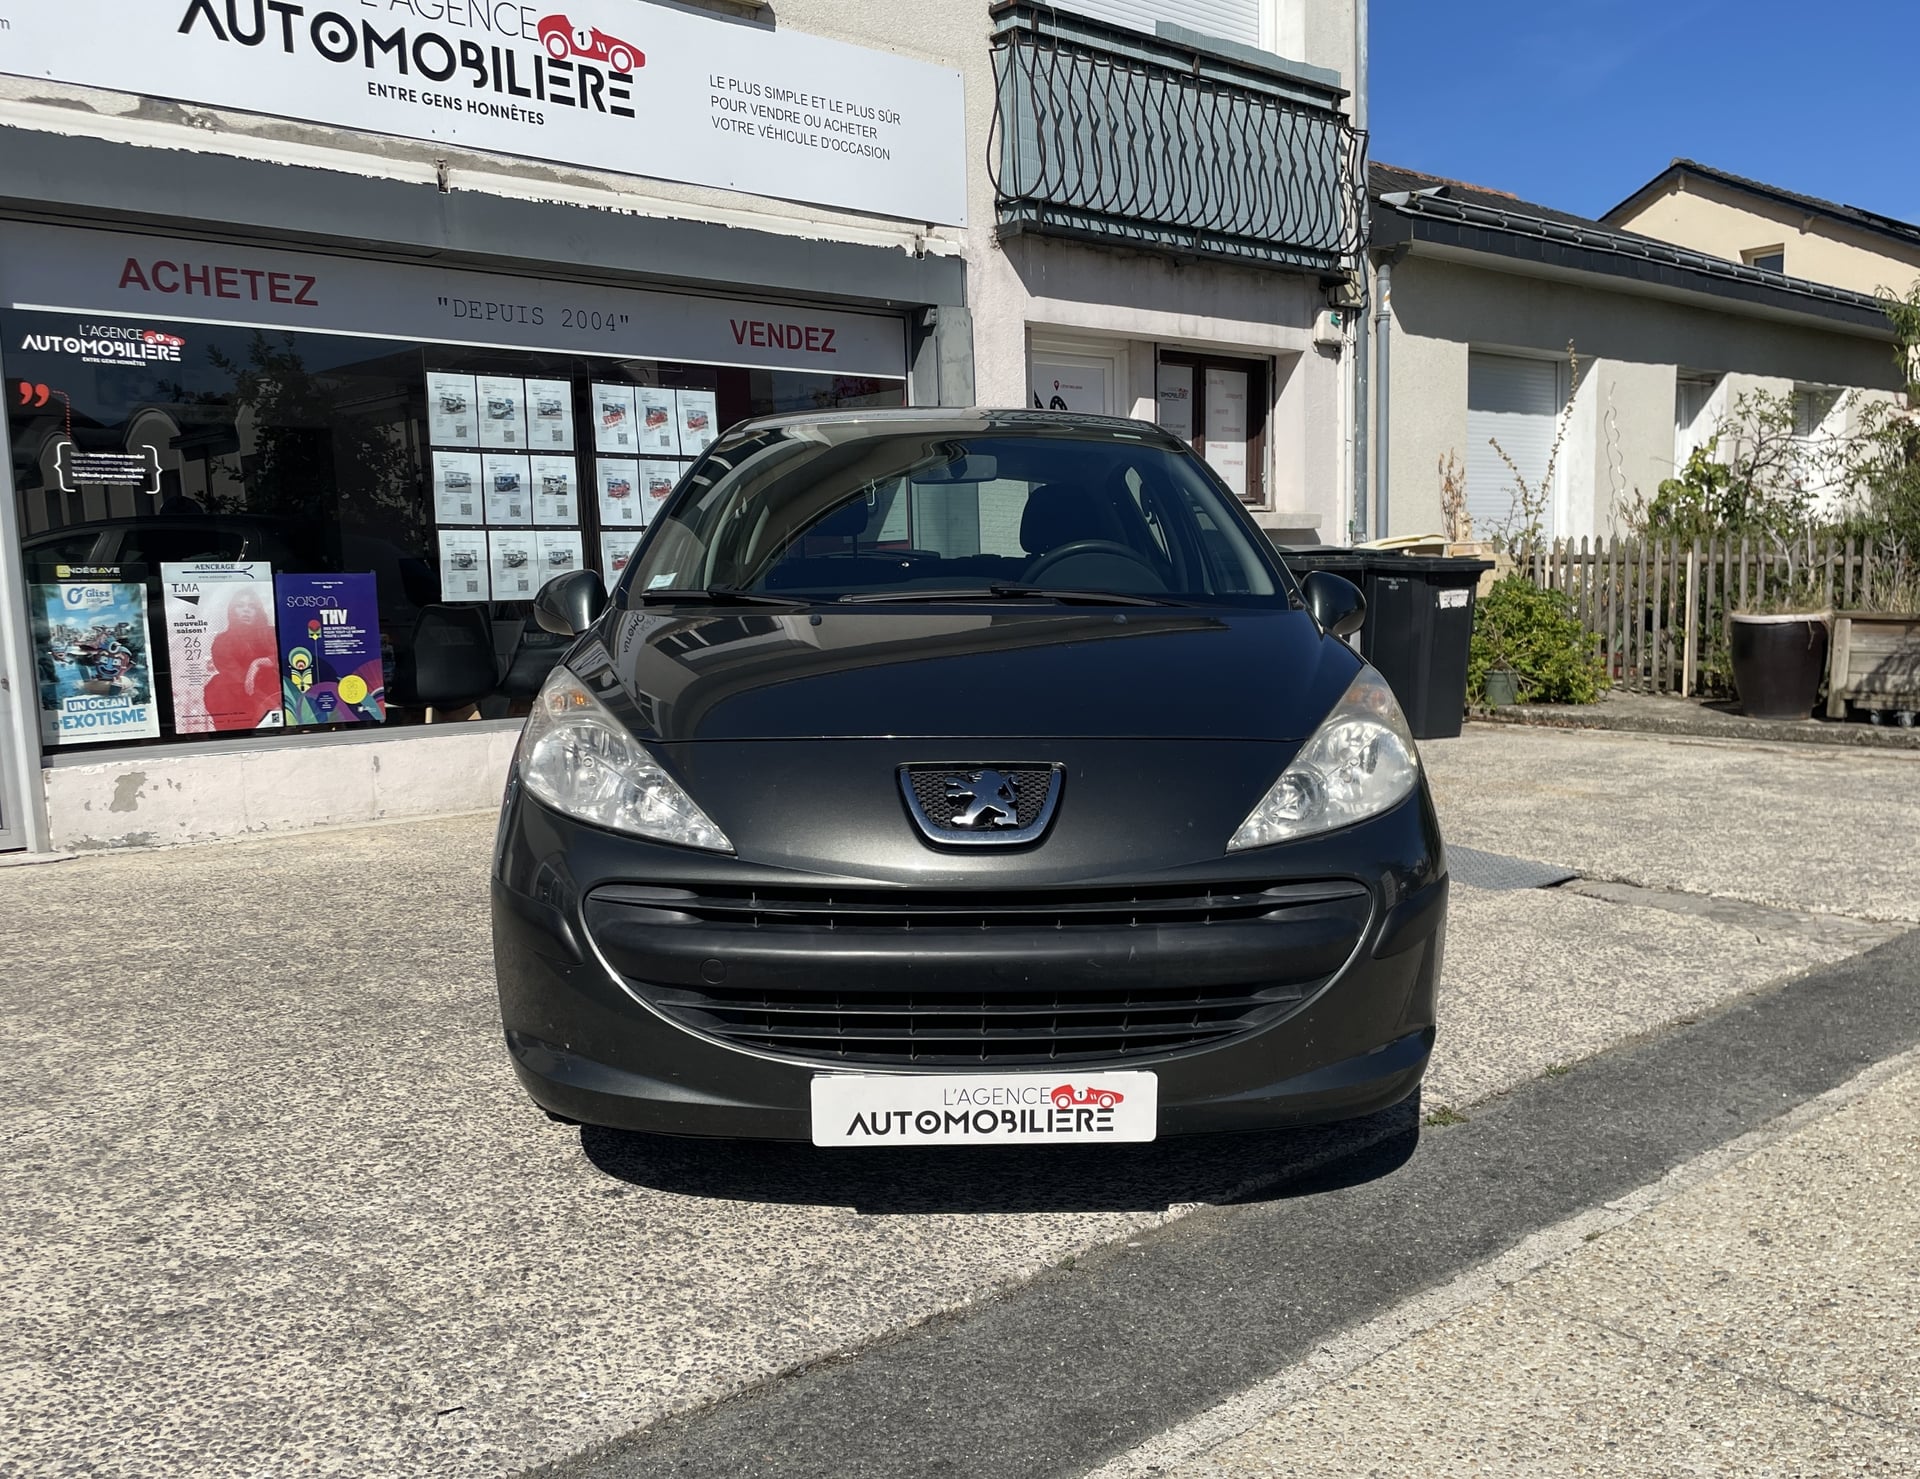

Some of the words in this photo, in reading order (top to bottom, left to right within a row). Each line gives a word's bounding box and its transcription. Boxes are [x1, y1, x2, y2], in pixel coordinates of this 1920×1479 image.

[577, 31, 585, 46] 1
[368, 81, 417, 102] ENTRE
[421, 92, 462, 111] GENS
[467, 100, 545, 125] HONNÊTES
[709, 74, 726, 90] LE
[728, 78, 761, 97] PLUS
[764, 86, 808, 106] SIMPLE
[811, 95, 826, 109] ET
[829, 98, 844, 113] LE
[846, 102, 876, 119] PLUS
[878, 108, 901, 126] SÛR
[711, 95, 748, 114] POUR
[750, 103, 800, 125] VENDRE
[803, 114, 821, 129] OU
[823, 118, 878, 139] ACHETER
[711, 115, 755, 136] VOTRE
[758, 124, 818, 147] VÉHICULE
[821, 136, 890, 160] D'OCCASION
[119, 257, 319, 306] ACHETEZ
[79, 324, 144, 341] L'AGENCE
[730, 319, 837, 353] VENDEZ
[86, 589, 110, 598] Gliss
[171, 583, 200, 593] T.MA
[286, 595, 338, 608] saison
[173, 619, 208, 627] nouvelle
[319, 609, 348, 625] THV
[176, 626, 203, 634] saison
[183, 636, 202, 649] 26
[184, 649, 202, 661] 27
[68, 701, 86, 712] UN
[88, 698, 127, 710] OCEAN
[52, 708, 147, 731] D'EXOTISME
[943, 1086, 1051, 1106] L'AGENCE
[1076, 1089, 1084, 1099] 1
